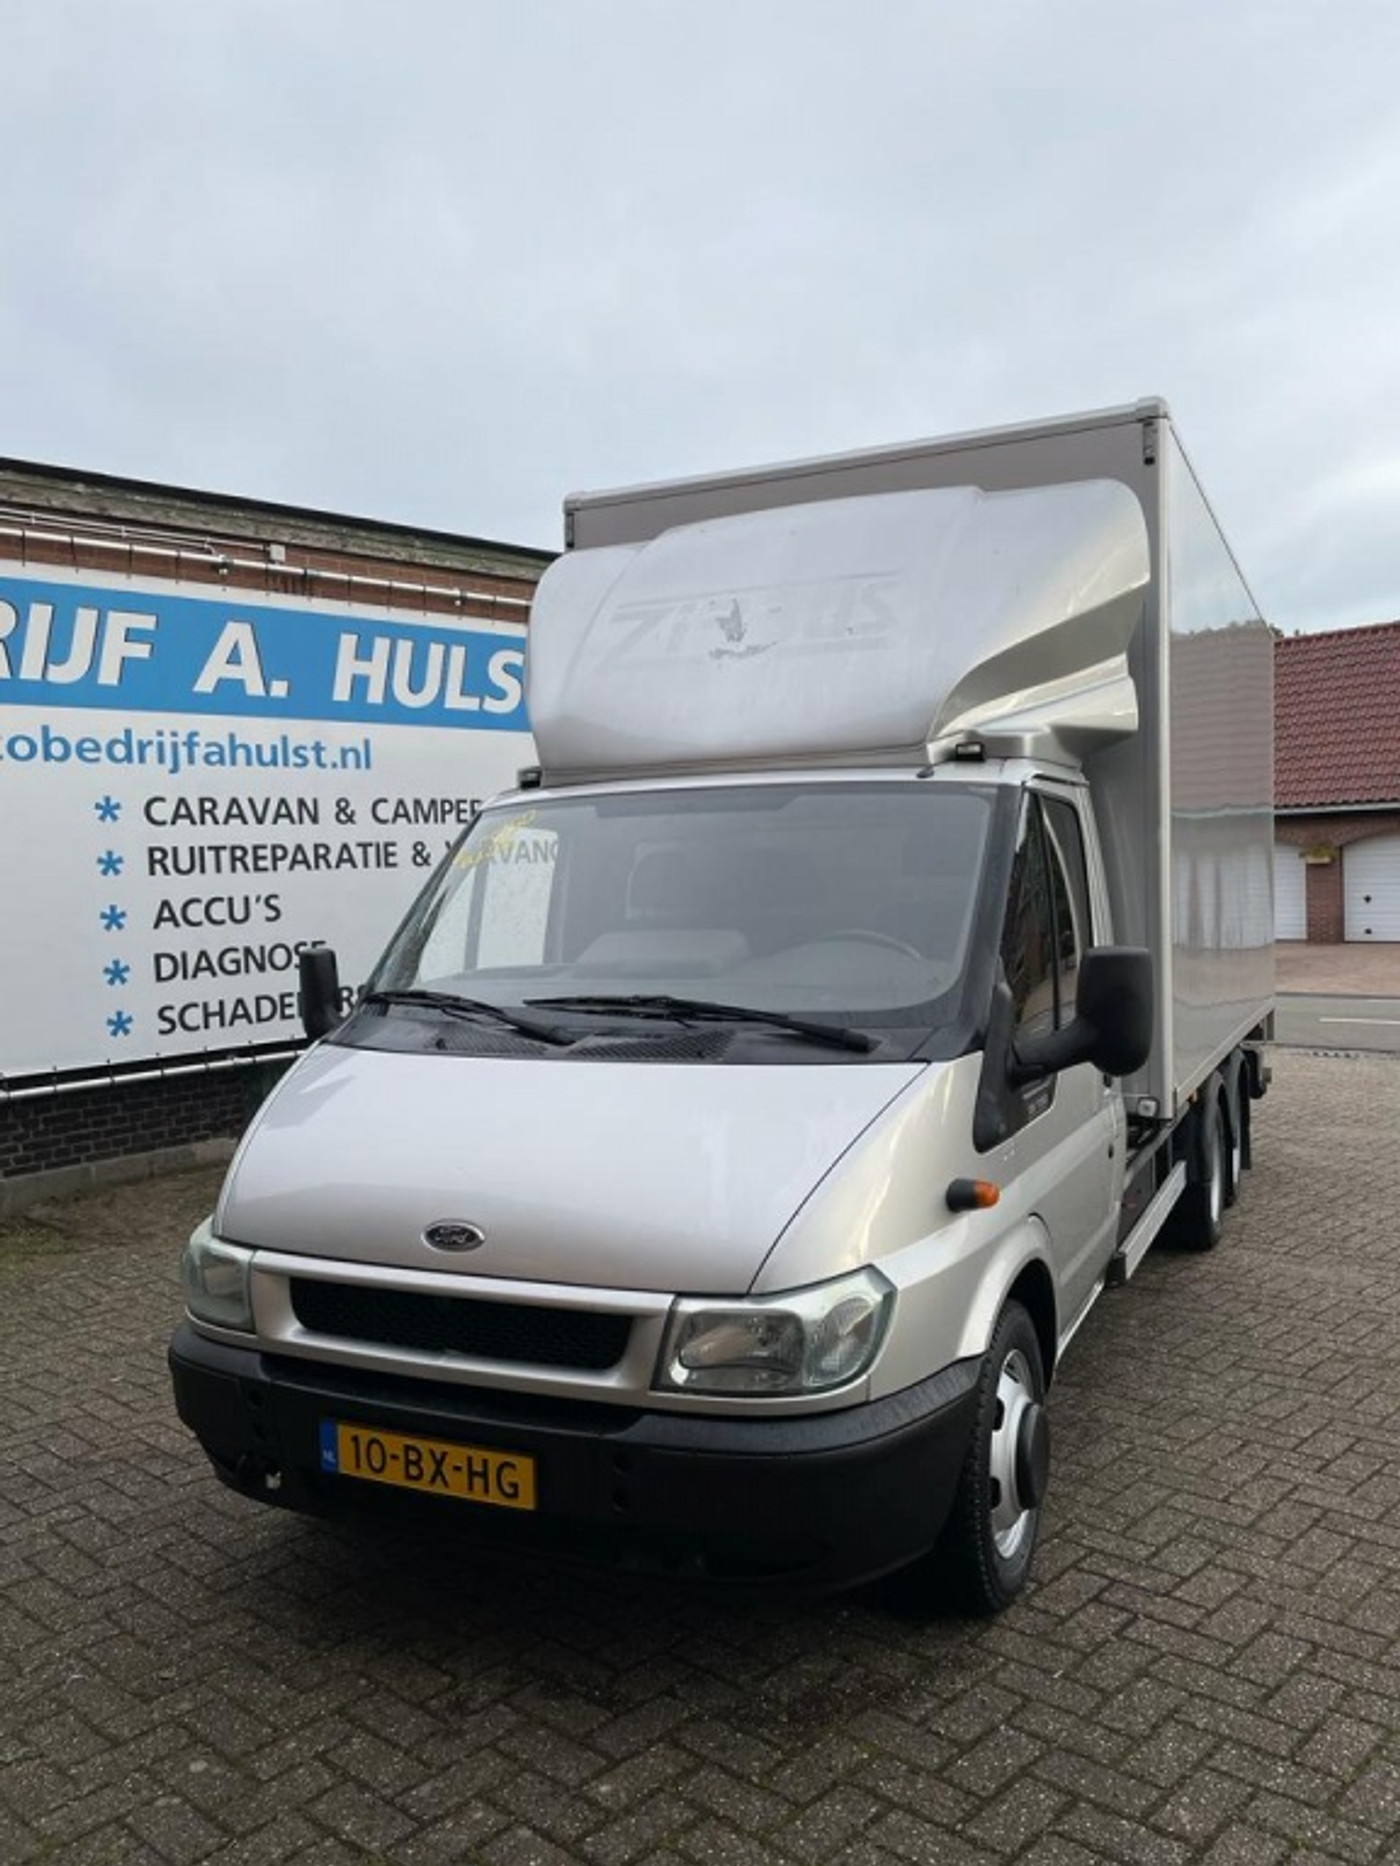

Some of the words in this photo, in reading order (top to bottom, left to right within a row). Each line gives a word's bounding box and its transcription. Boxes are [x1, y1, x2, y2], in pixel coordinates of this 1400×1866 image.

[192, 620, 290, 698] A.
[332, 632, 526, 714] HULS
[0, 724, 372, 774] obedrijfahulst.nl
[143, 796, 320, 827] CARAVAN
[334, 797, 357, 826] &
[147, 841, 399, 877] RUITREPARATIE
[411, 840, 432, 868] &
[152, 893, 282, 931] ACCU'S
[153, 940, 327, 984] DIAGNOS
[350, 1433, 521, 1500] 10-BX-HG
